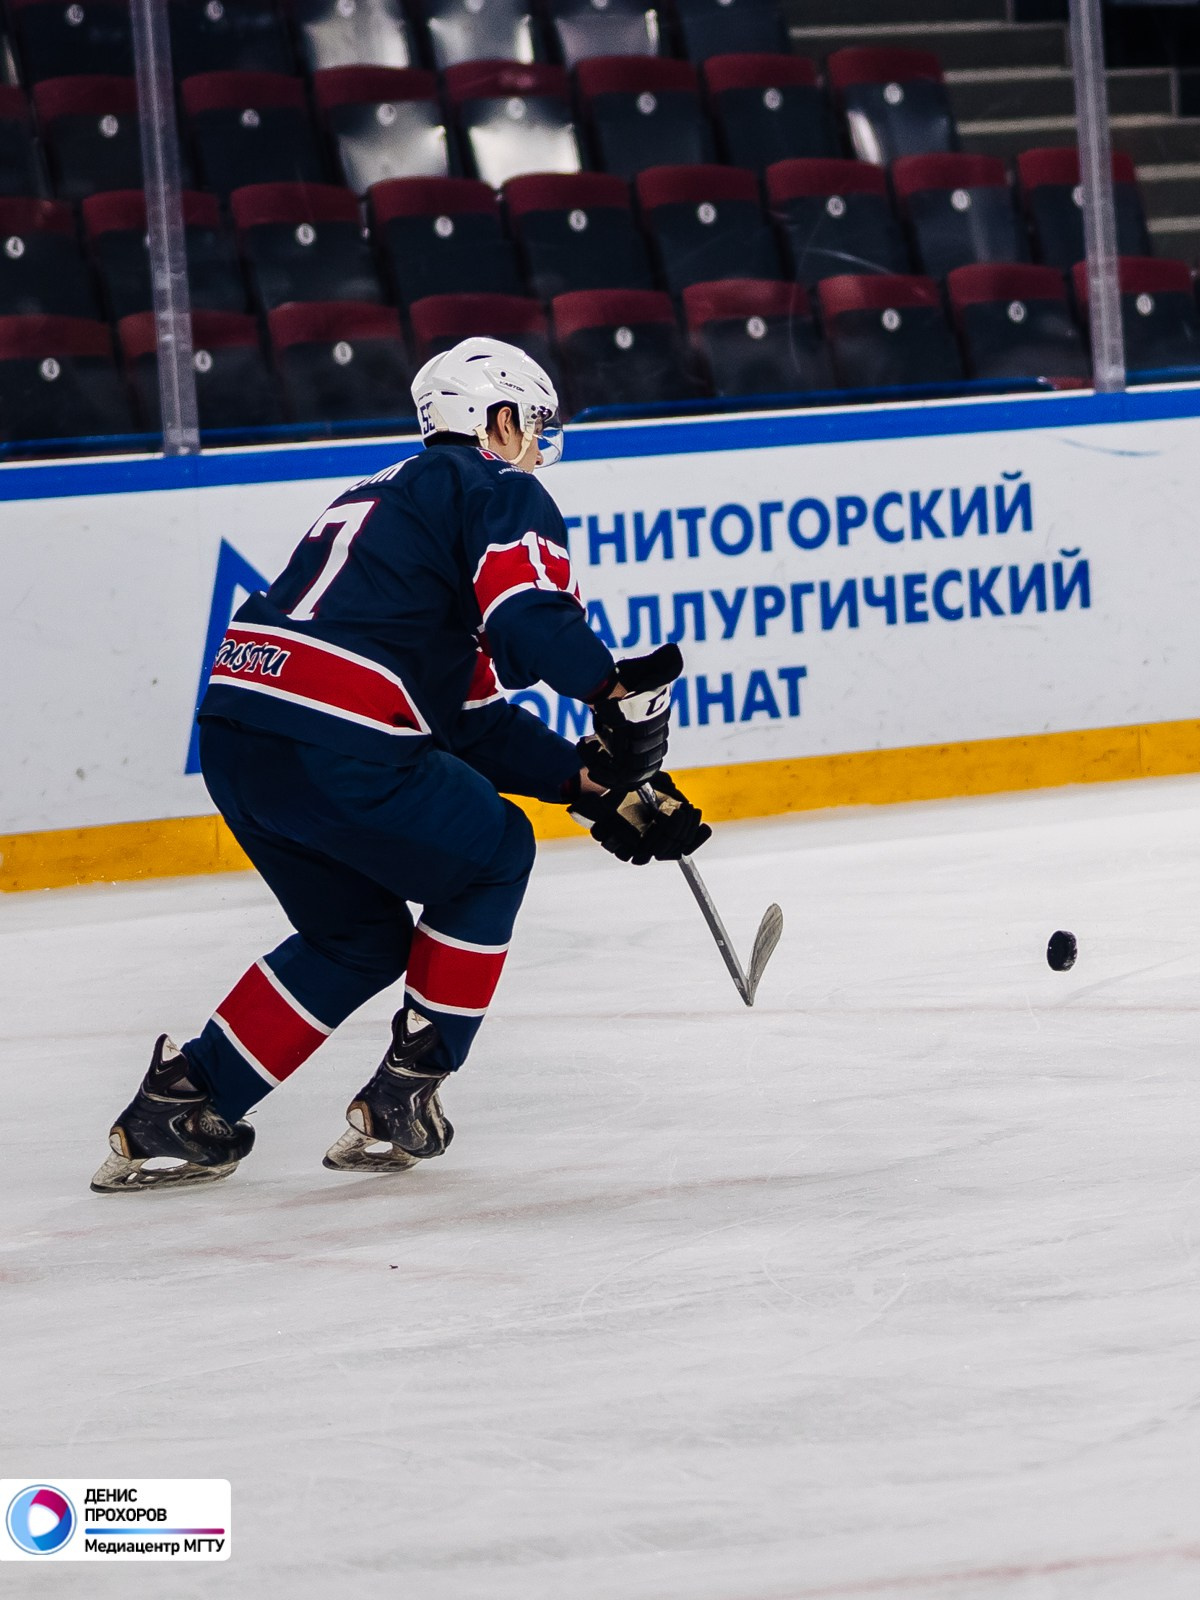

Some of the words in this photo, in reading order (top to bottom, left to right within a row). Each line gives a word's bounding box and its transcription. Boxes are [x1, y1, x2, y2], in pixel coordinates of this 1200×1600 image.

[563, 470, 1034, 567] НИТОГОРСКИЙ
[586, 547, 1092, 650] АЛЛУРГИЧЕСКИЙ
[507, 665, 808, 738] ОМИНАТ
